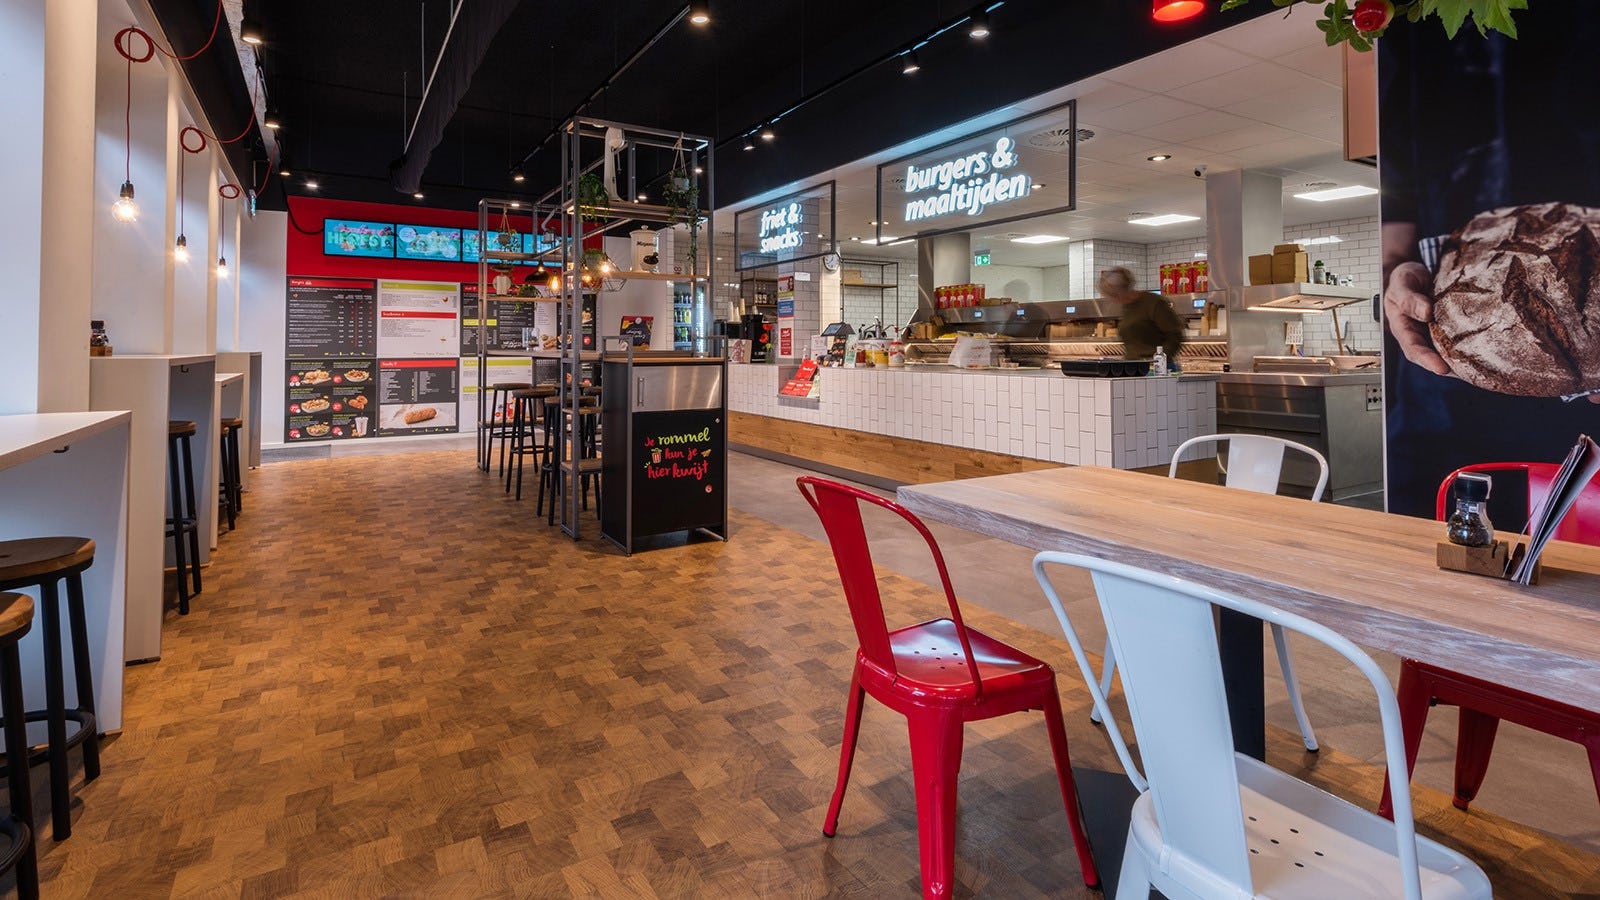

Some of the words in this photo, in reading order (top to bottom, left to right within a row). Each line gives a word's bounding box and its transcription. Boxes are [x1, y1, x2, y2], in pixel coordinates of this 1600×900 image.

[905, 151, 988, 192] burgers
[992, 137, 1013, 168] &
[905, 173, 1026, 221] maaltijden
[759, 208, 787, 237] friet
[788, 203, 799, 224] &
[760, 227, 799, 253] snacks
[644, 436, 656, 447] Je
[658, 427, 711, 446] rommel
[664, 447, 685, 460] kun
[687, 447, 698, 461] je
[647, 463, 672, 479] hier
[672, 460, 709, 481] kwijt
